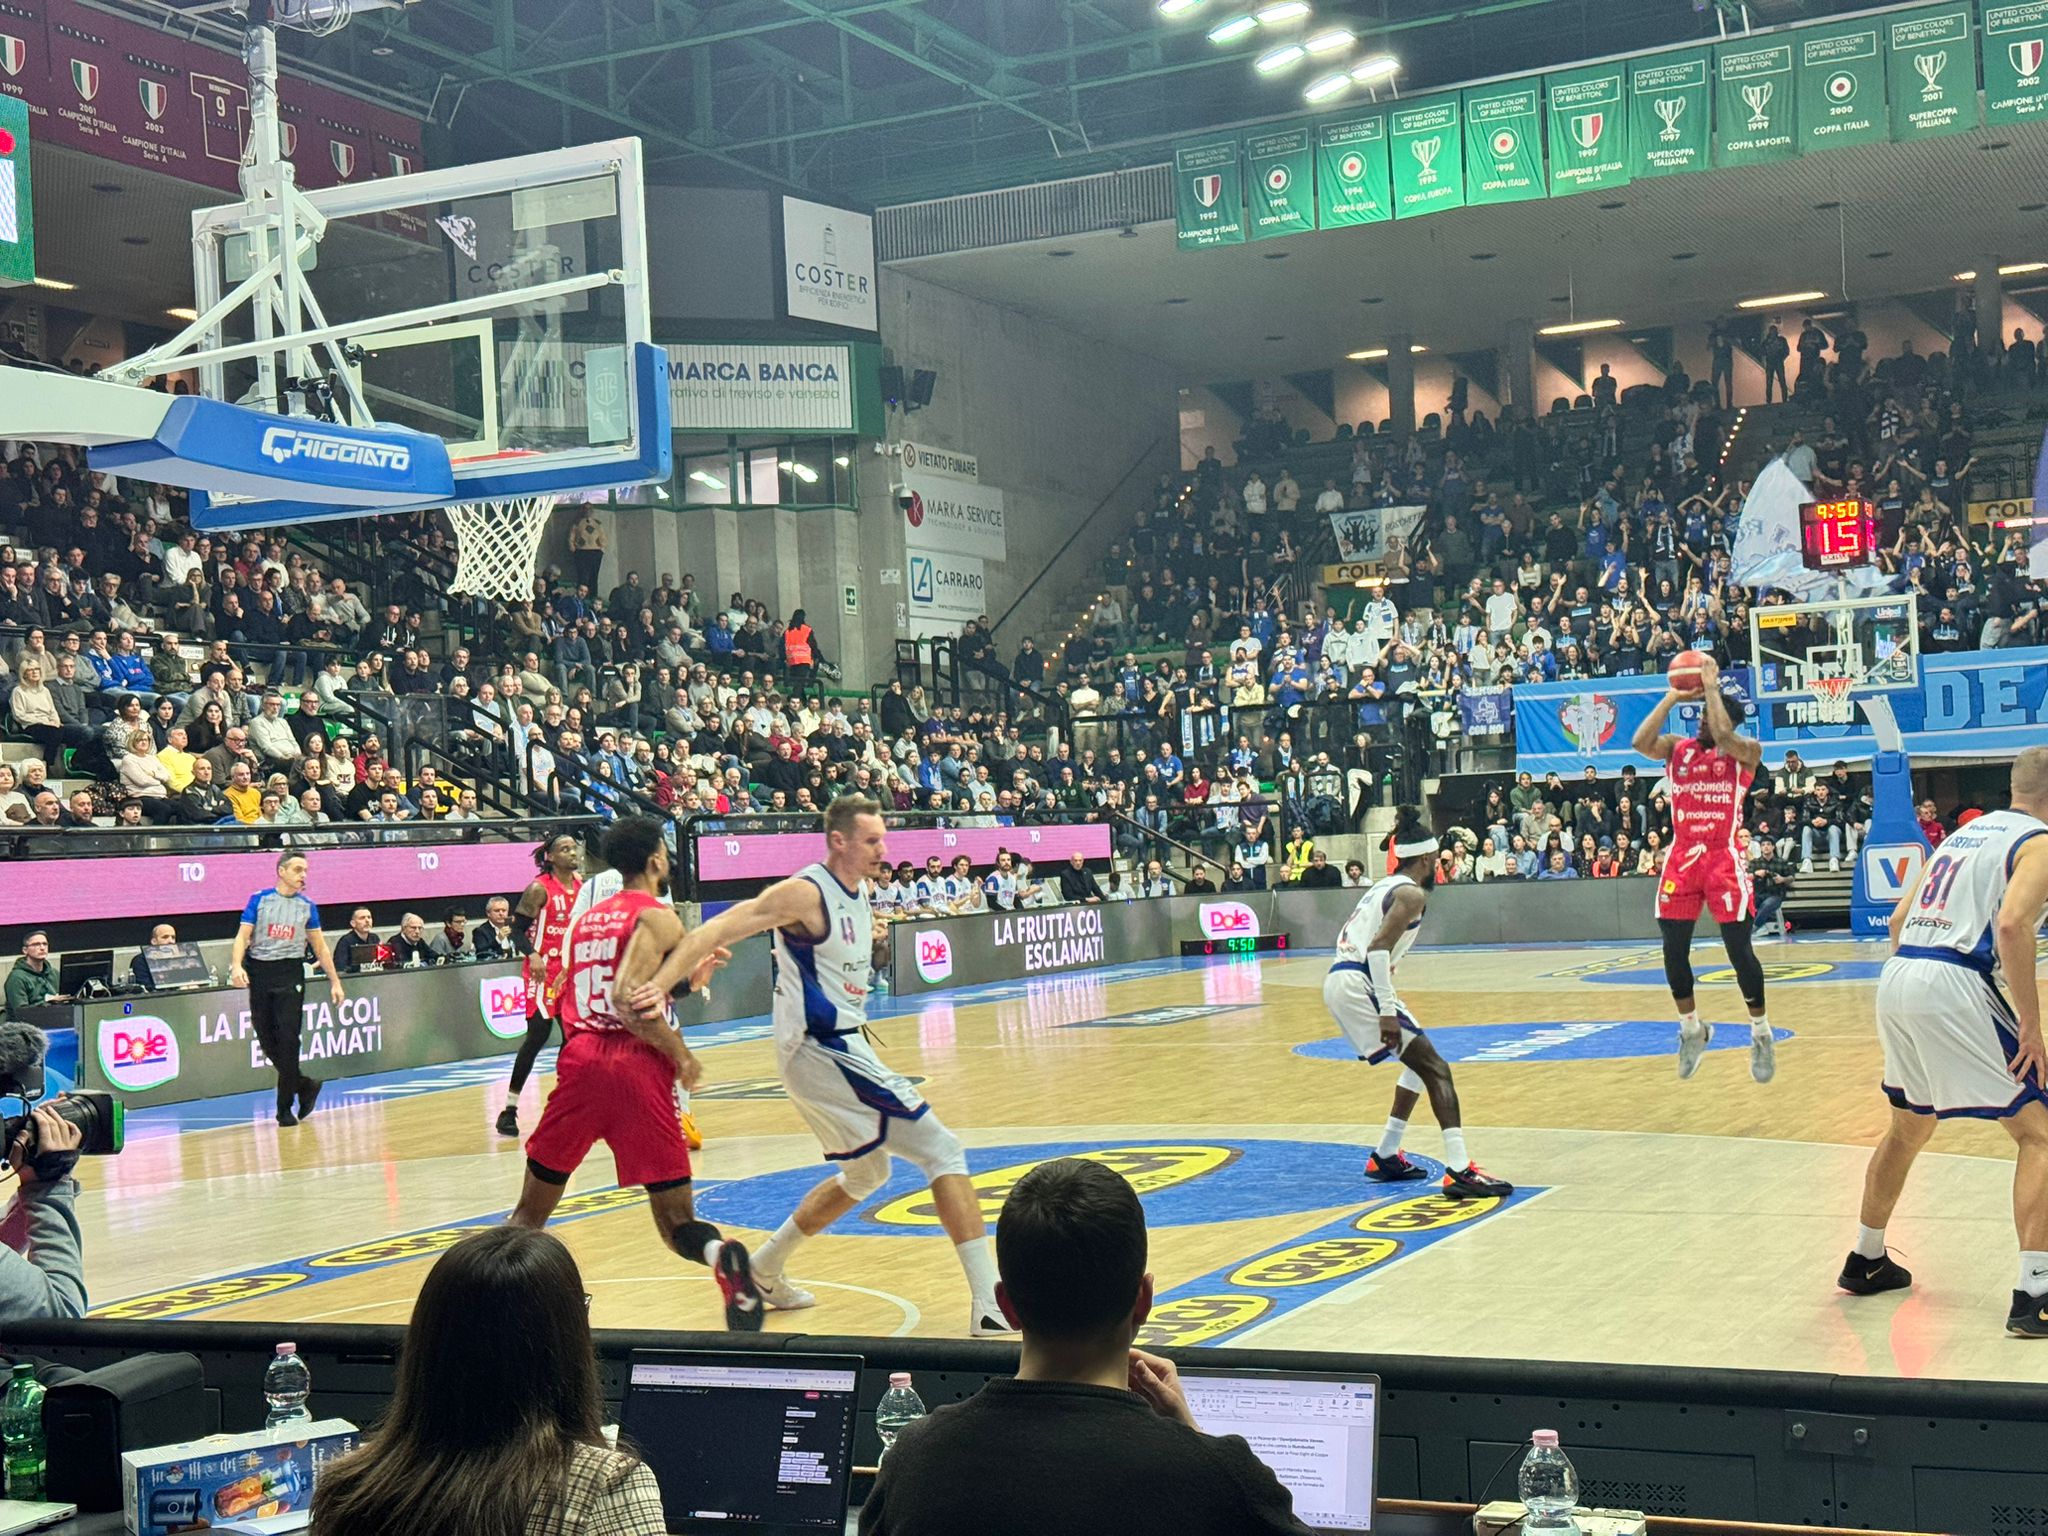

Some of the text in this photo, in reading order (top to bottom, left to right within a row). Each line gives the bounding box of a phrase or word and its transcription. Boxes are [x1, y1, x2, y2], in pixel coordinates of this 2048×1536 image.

[1990, 9, 2018, 20] UNITED
[1895, 19, 1954, 34] UNITED COLORS
[1990, 19, 2000, 28] OF
[1808, 36, 1864, 51] UNITED COLORS
[1896, 34, 1905, 42] OF
[1724, 51, 1779, 66] UNITED COLORS
[1808, 51, 1817, 59] OF
[1638, 65, 1693, 80] UNITED COLORS
[1724, 66, 1734, 74] OF
[2, 82, 23, 95] 1999
[1555, 82, 1609, 96] UNITED COLORS
[1477, 97, 1528, 111] UNITED COLORS
[1922, 91, 1944, 103] 2001
[1991, 95, 2034, 110] CAMPIONE
[29, 105, 48, 116] TALIA
[79, 103, 97, 115] 2001
[215, 95, 226, 117] 9
[1830, 105, 1854, 116] 2000
[2016, 102, 2045, 114] Serie A
[58, 107, 118, 133] CAMPIONE D'ITALIA
[1909, 106, 1959, 122] SUPERCOPPA
[145, 121, 164, 134] 2003
[1748, 121, 1769, 132] 1999
[1813, 120, 1870, 135] COPPA ITALIA
[1916, 116, 1952, 129] ITALIANA
[1660, 133, 1680, 143] 1997
[1727, 136, 1791, 151] COPPA SAPORTA
[122, 136, 187, 160] CAMPIONE D'ITALIA
[1647, 148, 1695, 160] SUPERCOPPA
[143, 150, 168, 163] Serie A
[1653, 157, 1689, 167] ITALIANA
[1555, 161, 1623, 180] CAMPIONE D'ITALIA
[1482, 177, 1530, 191] COPPA ITALIA
[1199, 211, 1218, 220] 1992
[1259, 211, 1301, 226] COPPA ITALIA
[1179, 223, 1239, 239] CAMPIONE D'ITALIA
[795, 263, 868, 294] COSTER
[759, 363, 839, 383] BANCA
[712, 387, 840, 401] di treviso e venezia
[261, 426, 410, 472] CHIGGIATO
[918, 450, 976, 477] VIETATO FUMARE
[927, 499, 1002, 528] MARKA SERVICE
[1817, 501, 1859, 520] 9:50
[1985, 501, 2032, 518] COL
[1823, 519, 1859, 553] 15
[936, 570, 983, 590] CARRARO
[552, 894, 567, 911] 11
[1721, 891, 1734, 912] 1
[994, 908, 1104, 946] LA FRUTTA COL
[1210, 910, 1251, 931] Dole
[921, 939, 947, 964] Dole
[1226, 937, 1256, 952] 9:50
[1025, 936, 1105, 971] ESCLAMATI
[200, 996, 382, 1044] LA FTA COL
[113, 1030, 168, 1066] Dole
[1244, 1241, 1386, 1283] CRICH
[100, 1277, 292, 1315] RICH
[1134, 1298, 1258, 1346] RICH
